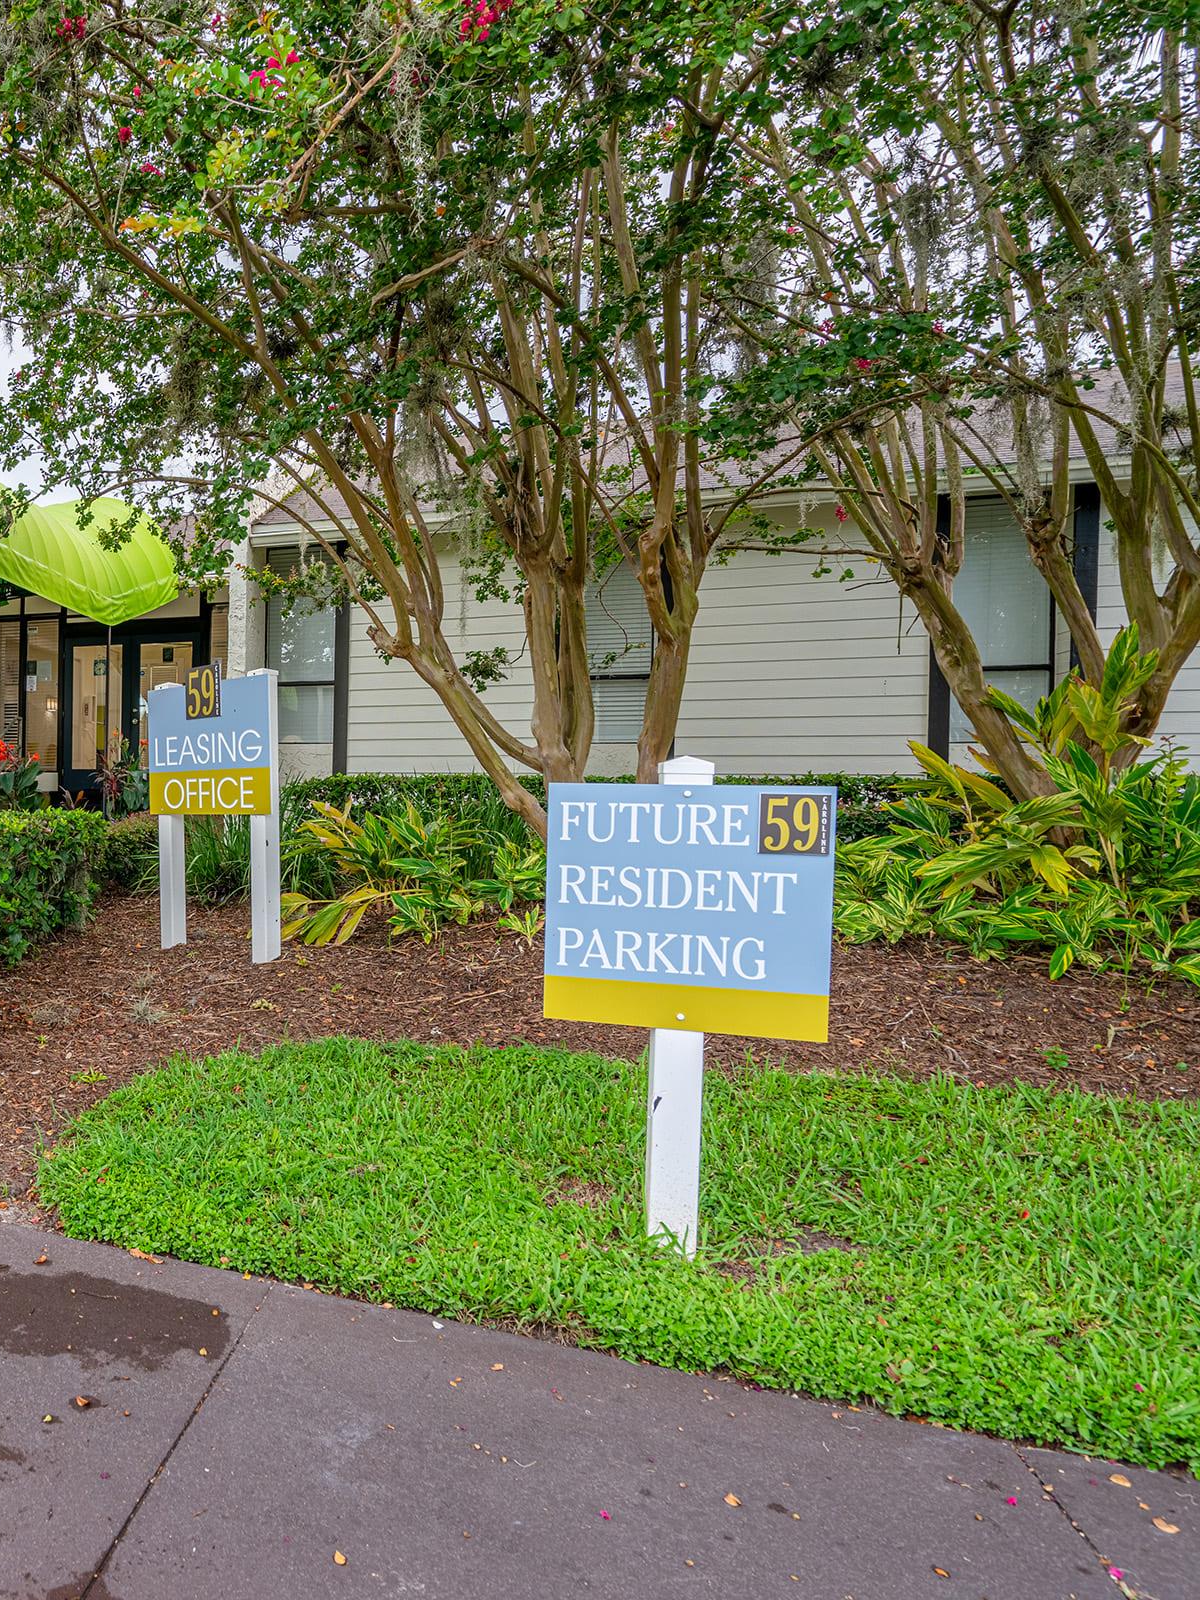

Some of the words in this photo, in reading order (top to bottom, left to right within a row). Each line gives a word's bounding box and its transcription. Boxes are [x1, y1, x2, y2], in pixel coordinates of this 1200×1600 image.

[188, 668, 215, 718] 59
[154, 729, 263, 767] LEASING
[164, 776, 255, 809] OFFICE
[559, 801, 750, 847] FUTURE
[763, 796, 820, 852] 59
[820, 796, 828, 854] CAROLINE
[558, 864, 798, 916] RESIDENT
[556, 927, 767, 981] PARKING
